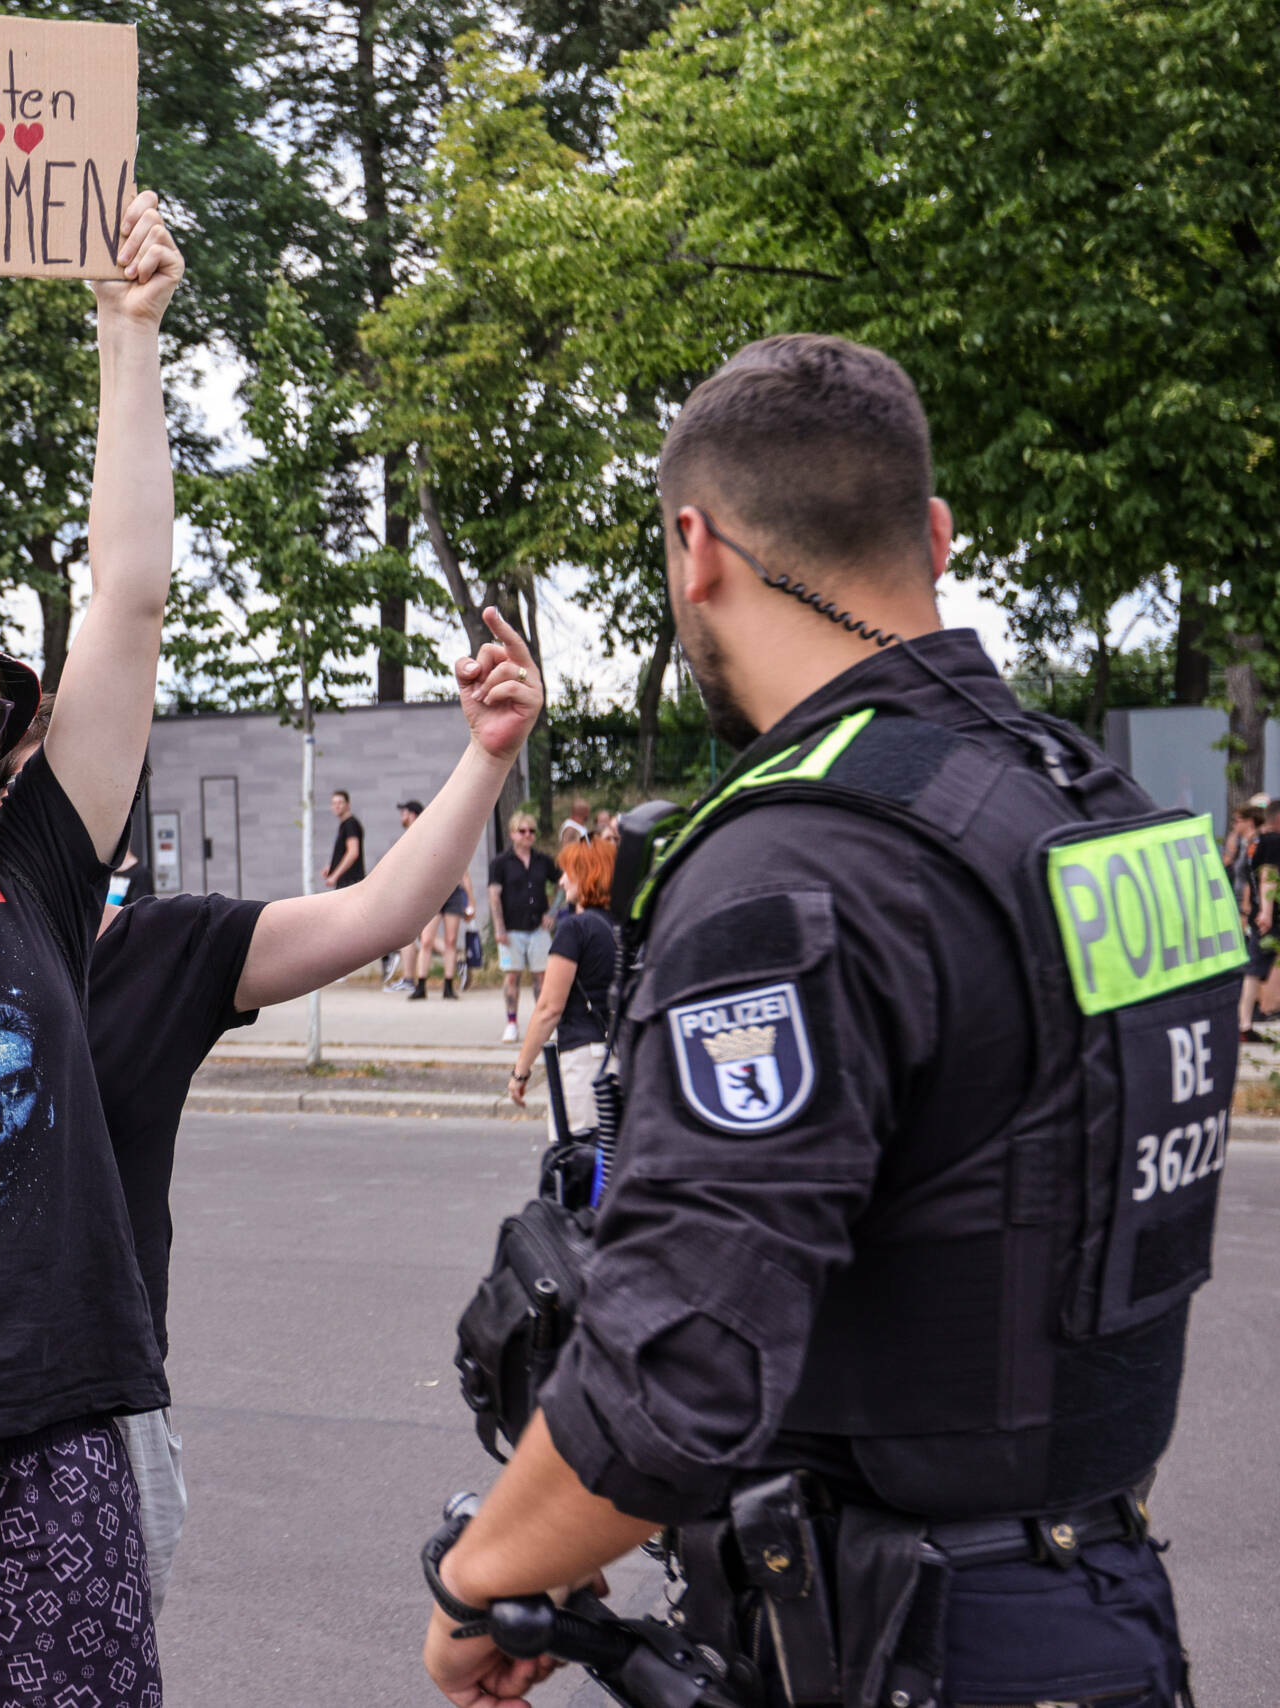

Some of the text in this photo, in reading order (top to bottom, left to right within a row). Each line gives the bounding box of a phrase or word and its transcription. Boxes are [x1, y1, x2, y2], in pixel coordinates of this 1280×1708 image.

[1059, 834, 1238, 994] POLIZE
[681, 994, 790, 1038] POLIZEI
[1166, 1019, 1214, 1104] BE
